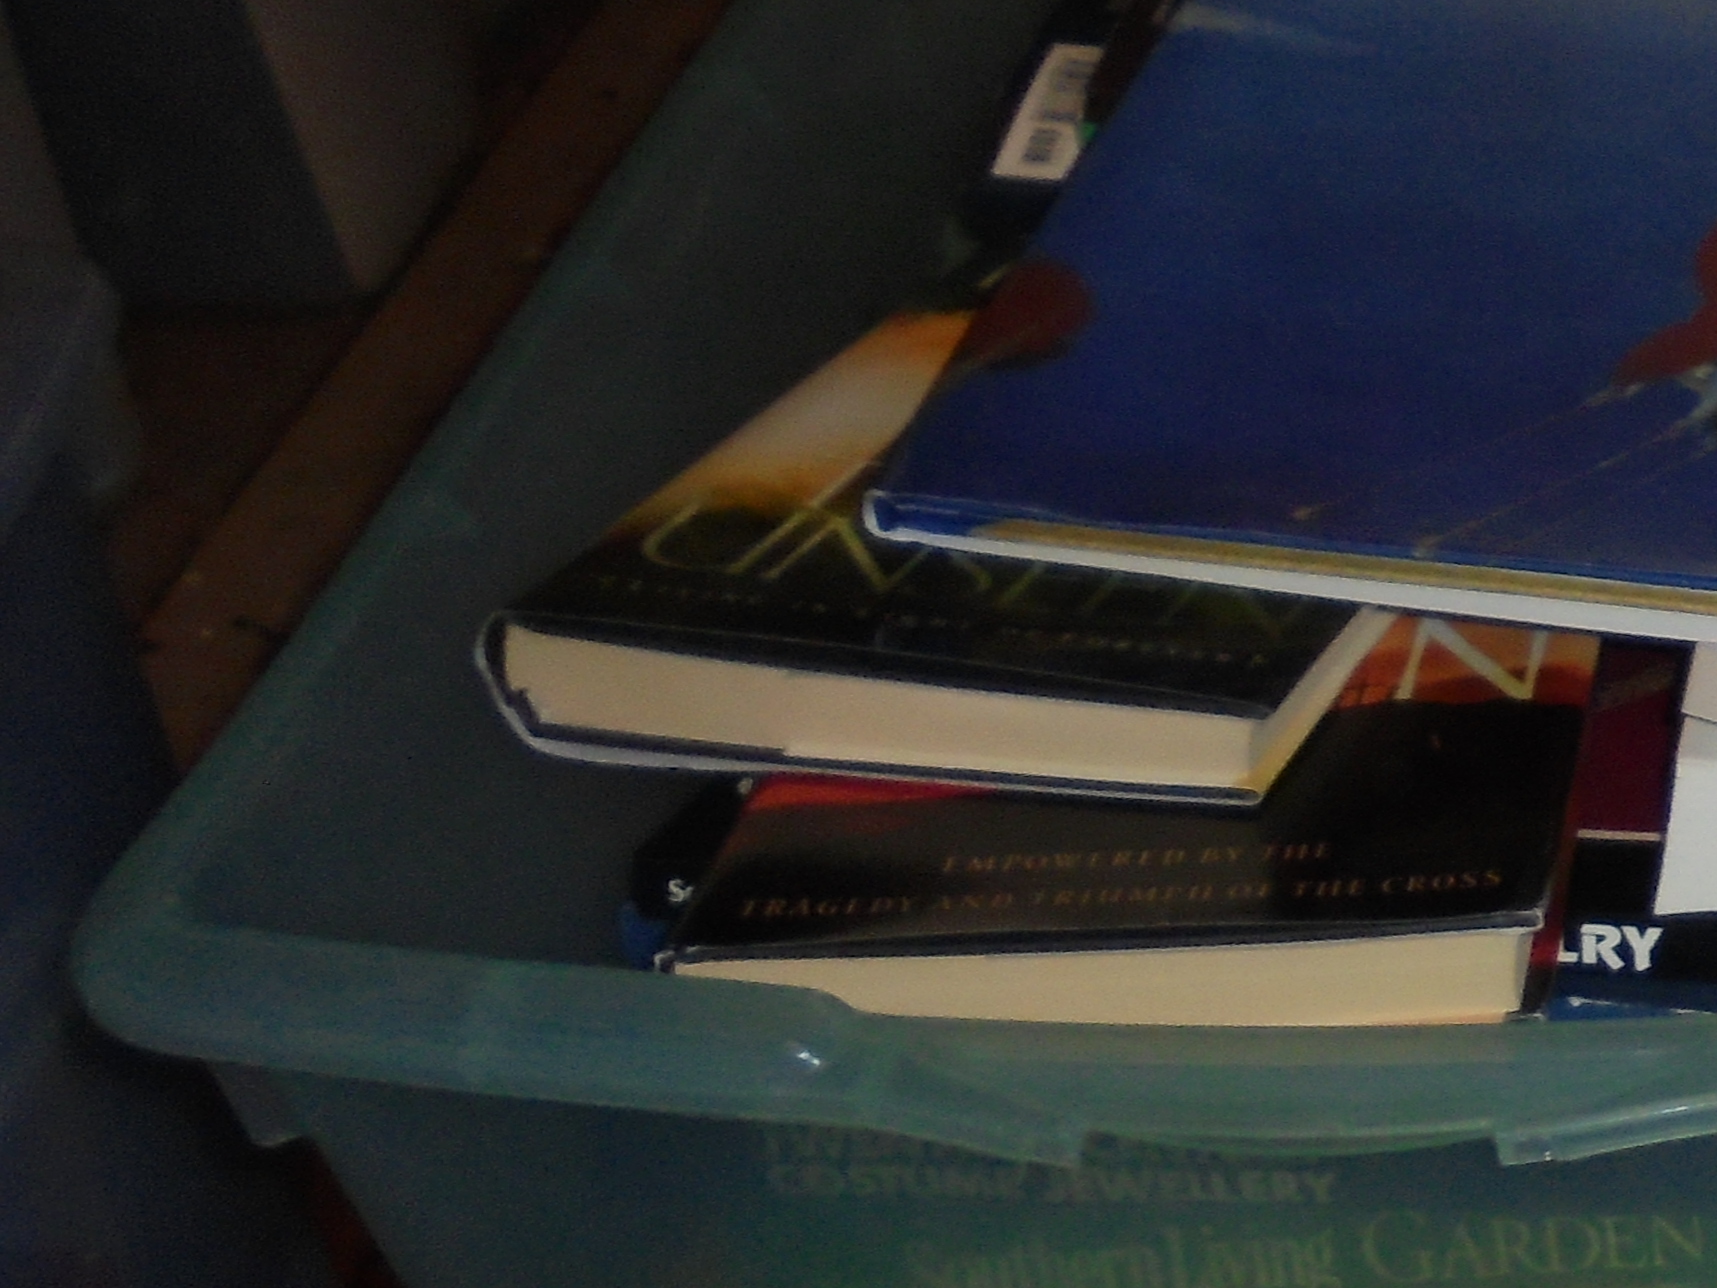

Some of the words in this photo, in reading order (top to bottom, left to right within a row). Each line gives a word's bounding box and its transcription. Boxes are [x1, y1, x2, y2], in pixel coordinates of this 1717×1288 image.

[941, 845, 1186, 875] EMPOWERED
[1198, 845, 1247, 866] BY
[931, 890, 1016, 913] AND
[1290, 877, 1370, 900] THE
[1381, 867, 1505, 895] CROSS
[1361, 1209, 1705, 1283] GARDEN
